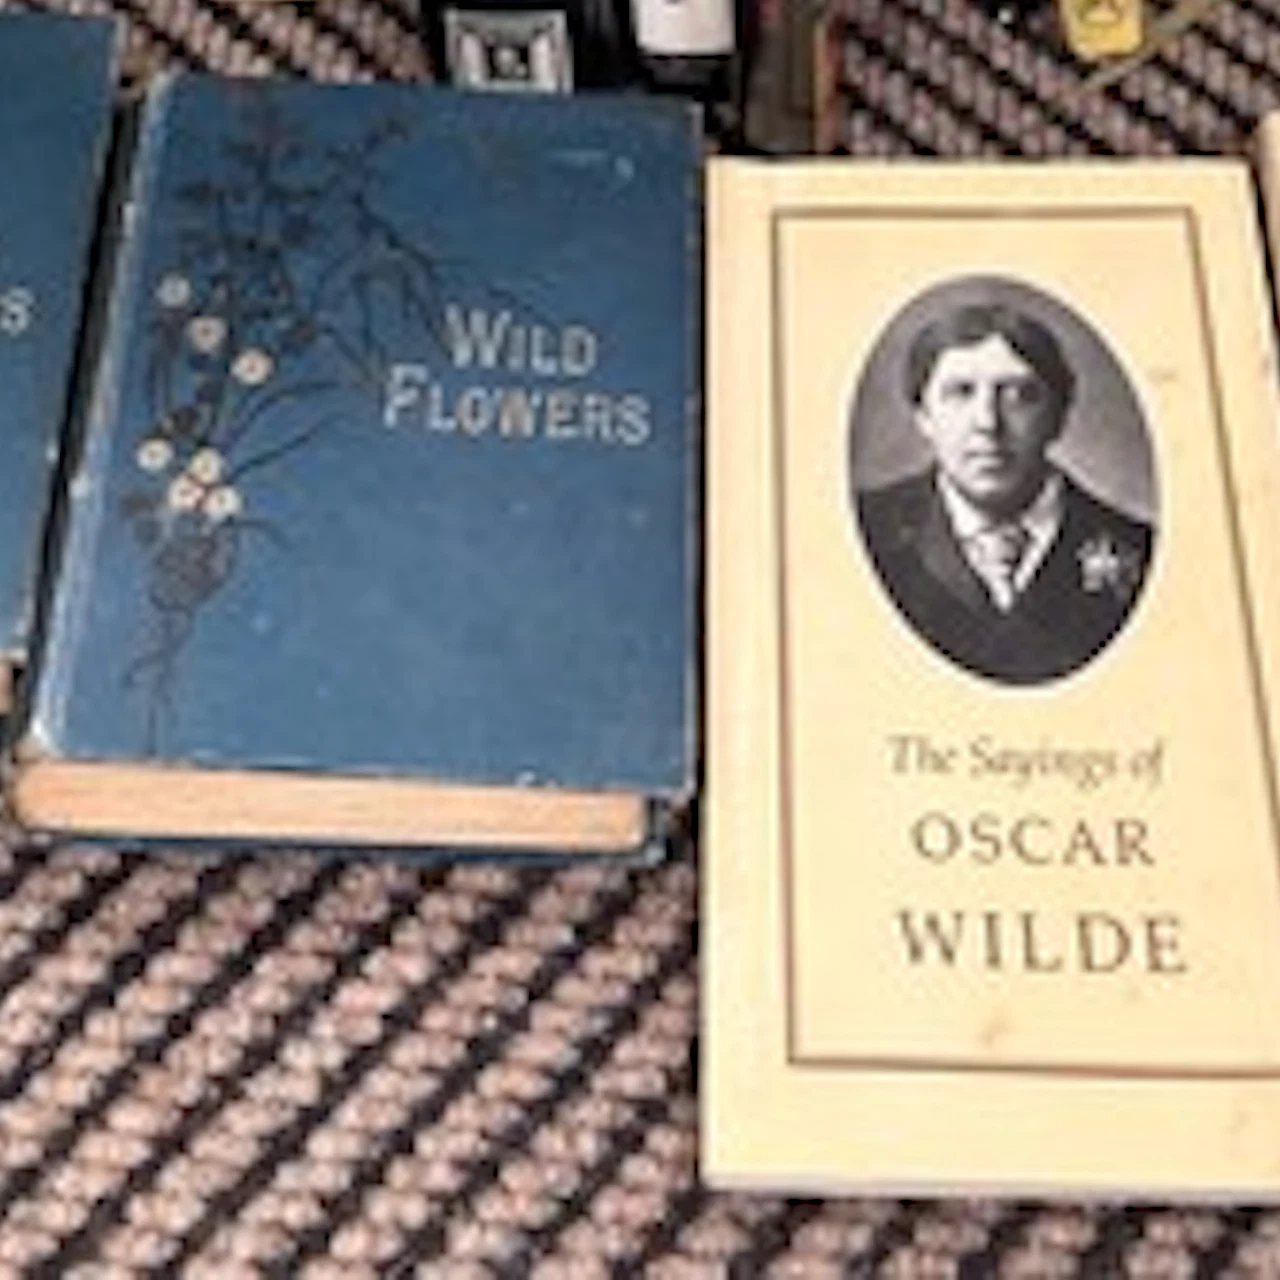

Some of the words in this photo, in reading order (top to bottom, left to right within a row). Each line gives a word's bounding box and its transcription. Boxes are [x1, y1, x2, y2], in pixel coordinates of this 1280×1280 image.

[444, 304, 600, 380] WILD
[381, 364, 653, 446] FLOWERS
[886, 734, 960, 776] The
[970, 736, 1118, 792] Sayings
[1128, 736, 1168, 790] of
[910, 810, 1157, 868] OSCAR
[897, 908, 1190, 976] WILDE
